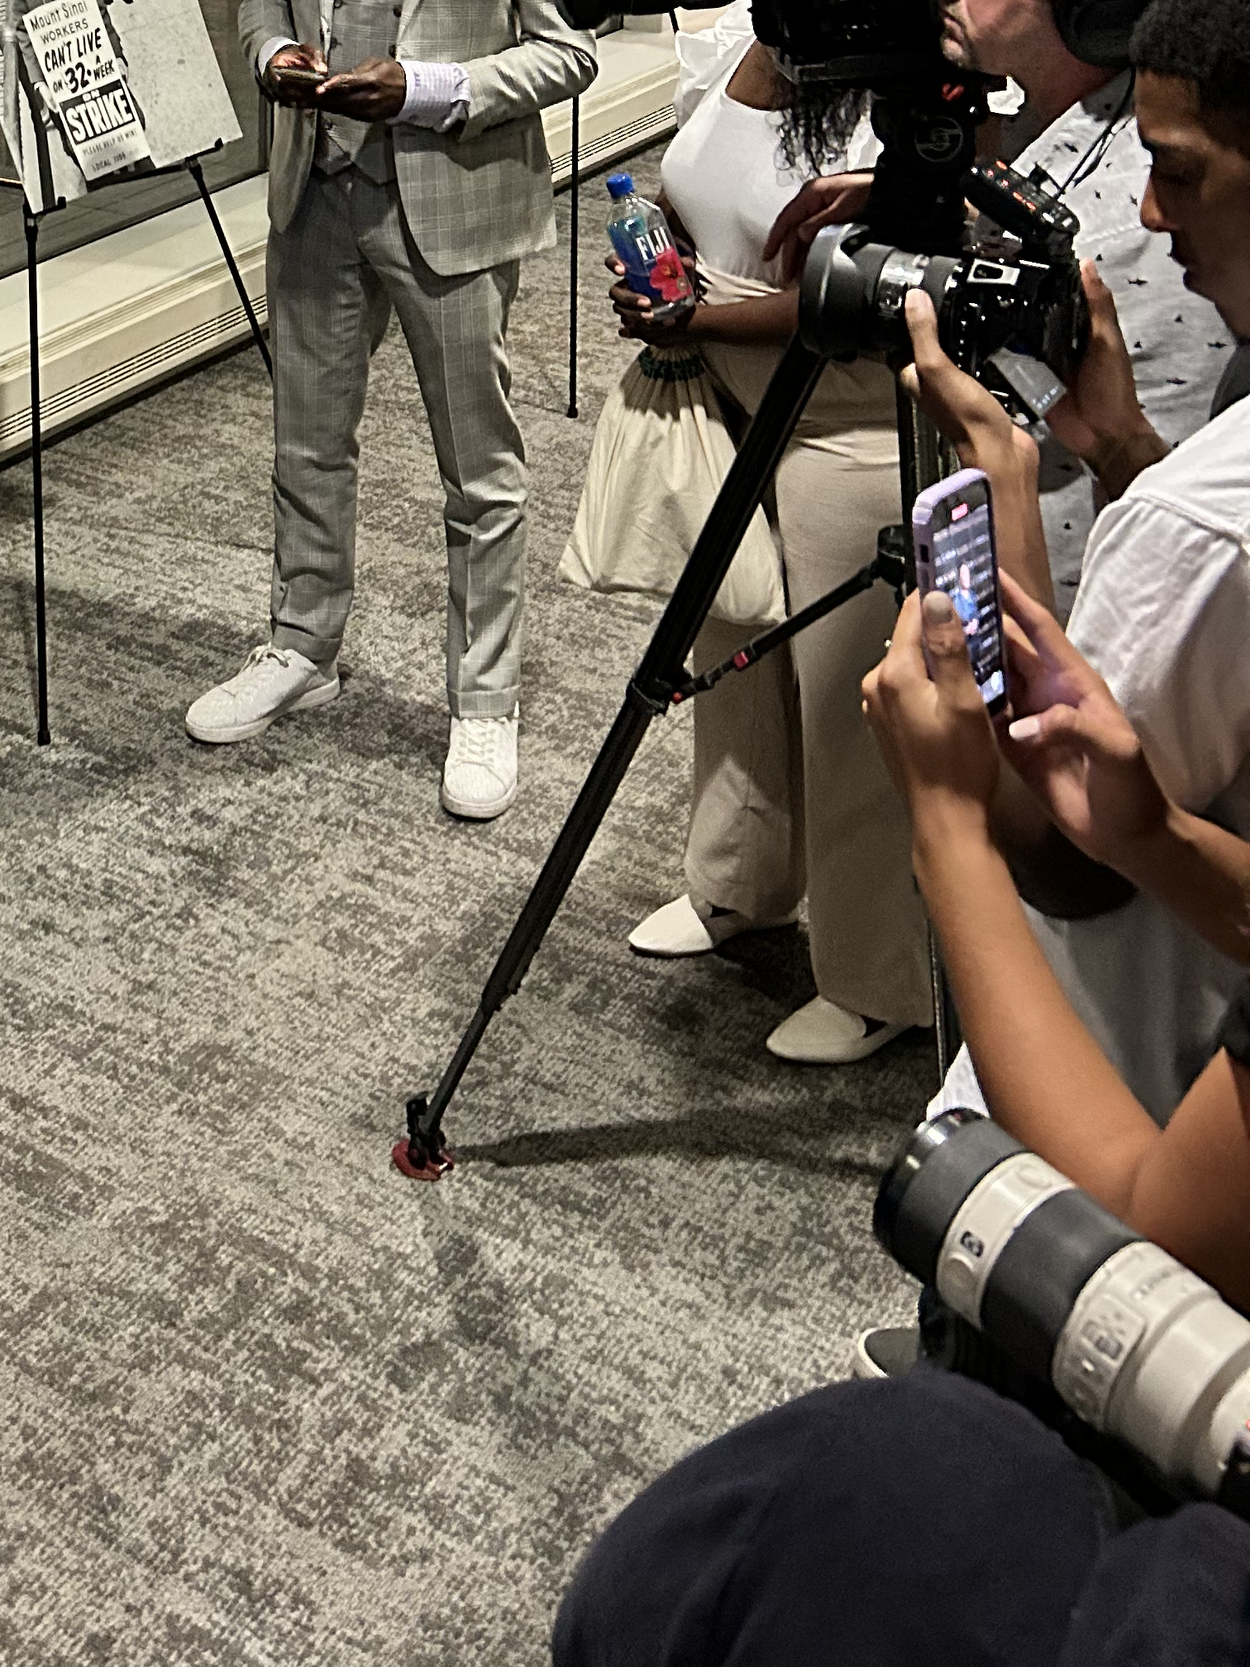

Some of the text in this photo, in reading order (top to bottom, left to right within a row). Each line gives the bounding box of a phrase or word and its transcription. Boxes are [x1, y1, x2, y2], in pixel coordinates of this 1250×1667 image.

[29, 0, 88, 31] Mount Sinai
[40, 18, 89, 44] WORKERS
[76, 28, 102, 58] LIVE
[53, 81, 63, 94] ON
[93, 59, 115, 80] WEEK
[65, 88, 133, 142] STRIKE
[635, 226, 671, 261] FIJI
